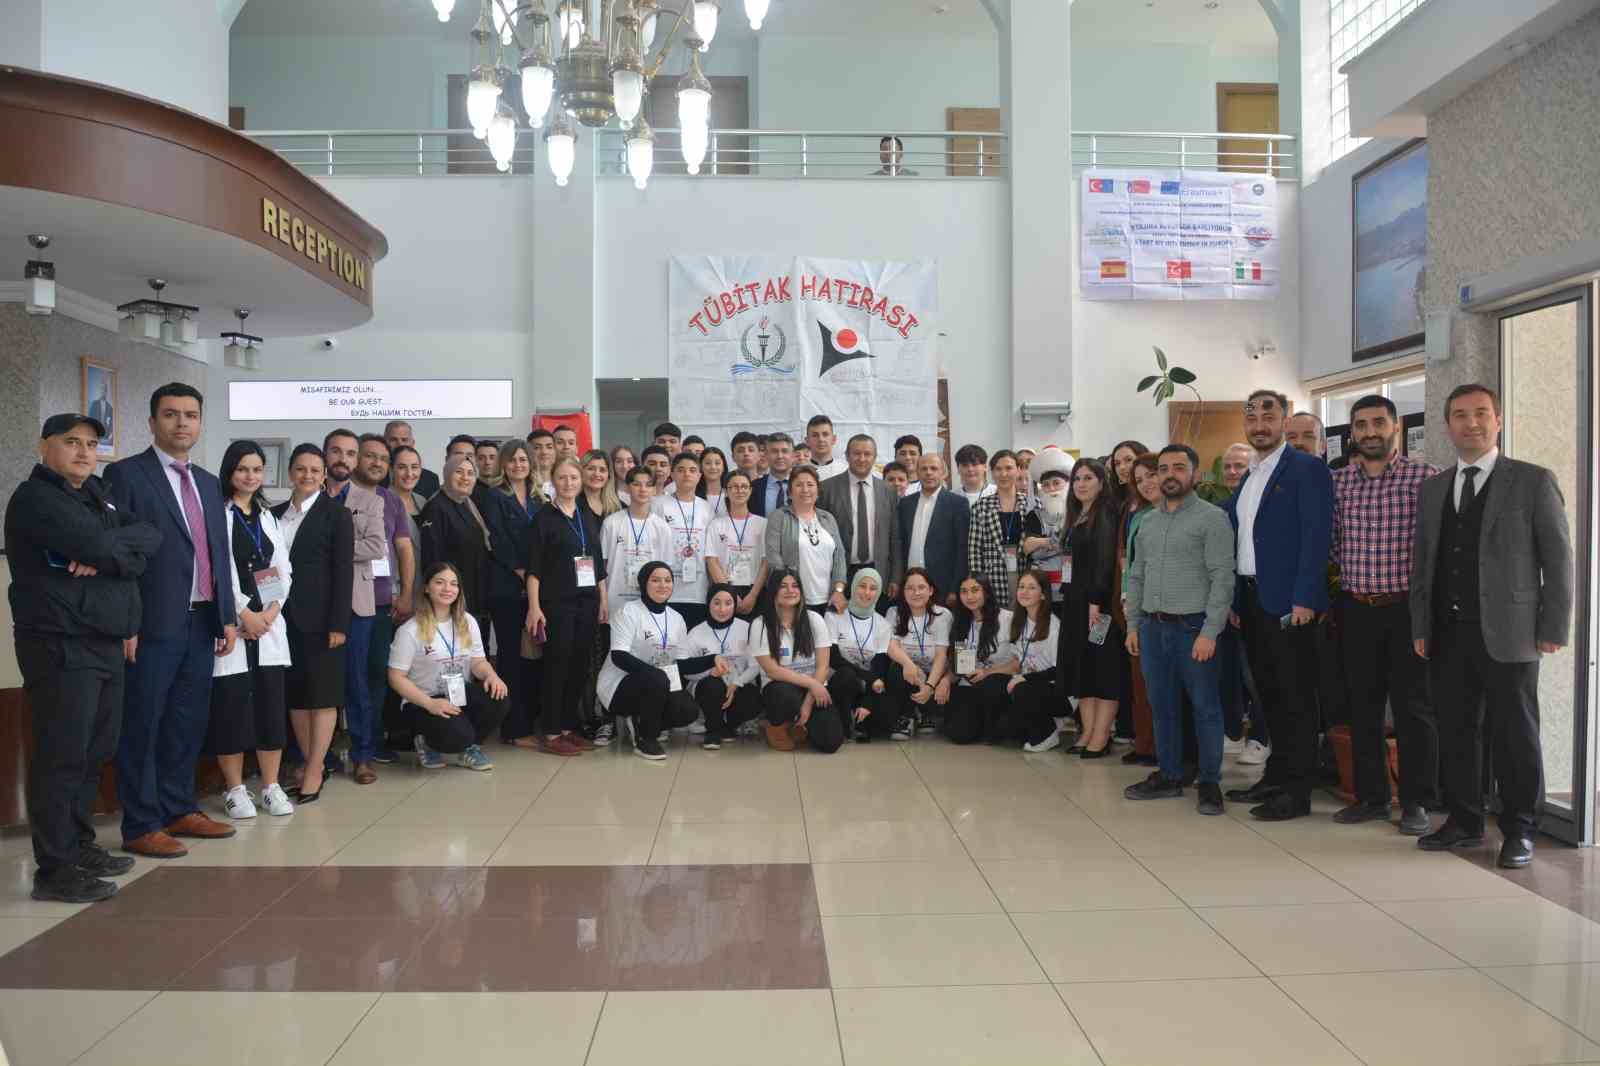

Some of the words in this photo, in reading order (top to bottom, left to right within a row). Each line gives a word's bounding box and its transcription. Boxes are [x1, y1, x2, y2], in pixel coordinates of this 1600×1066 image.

[263, 197, 366, 289] RECEPTION
[688, 276, 793, 336] TÜBİTAK
[800, 274, 920, 339] HATIRASI
[328, 398, 339, 406] BE
[341, 398, 356, 406] OUR
